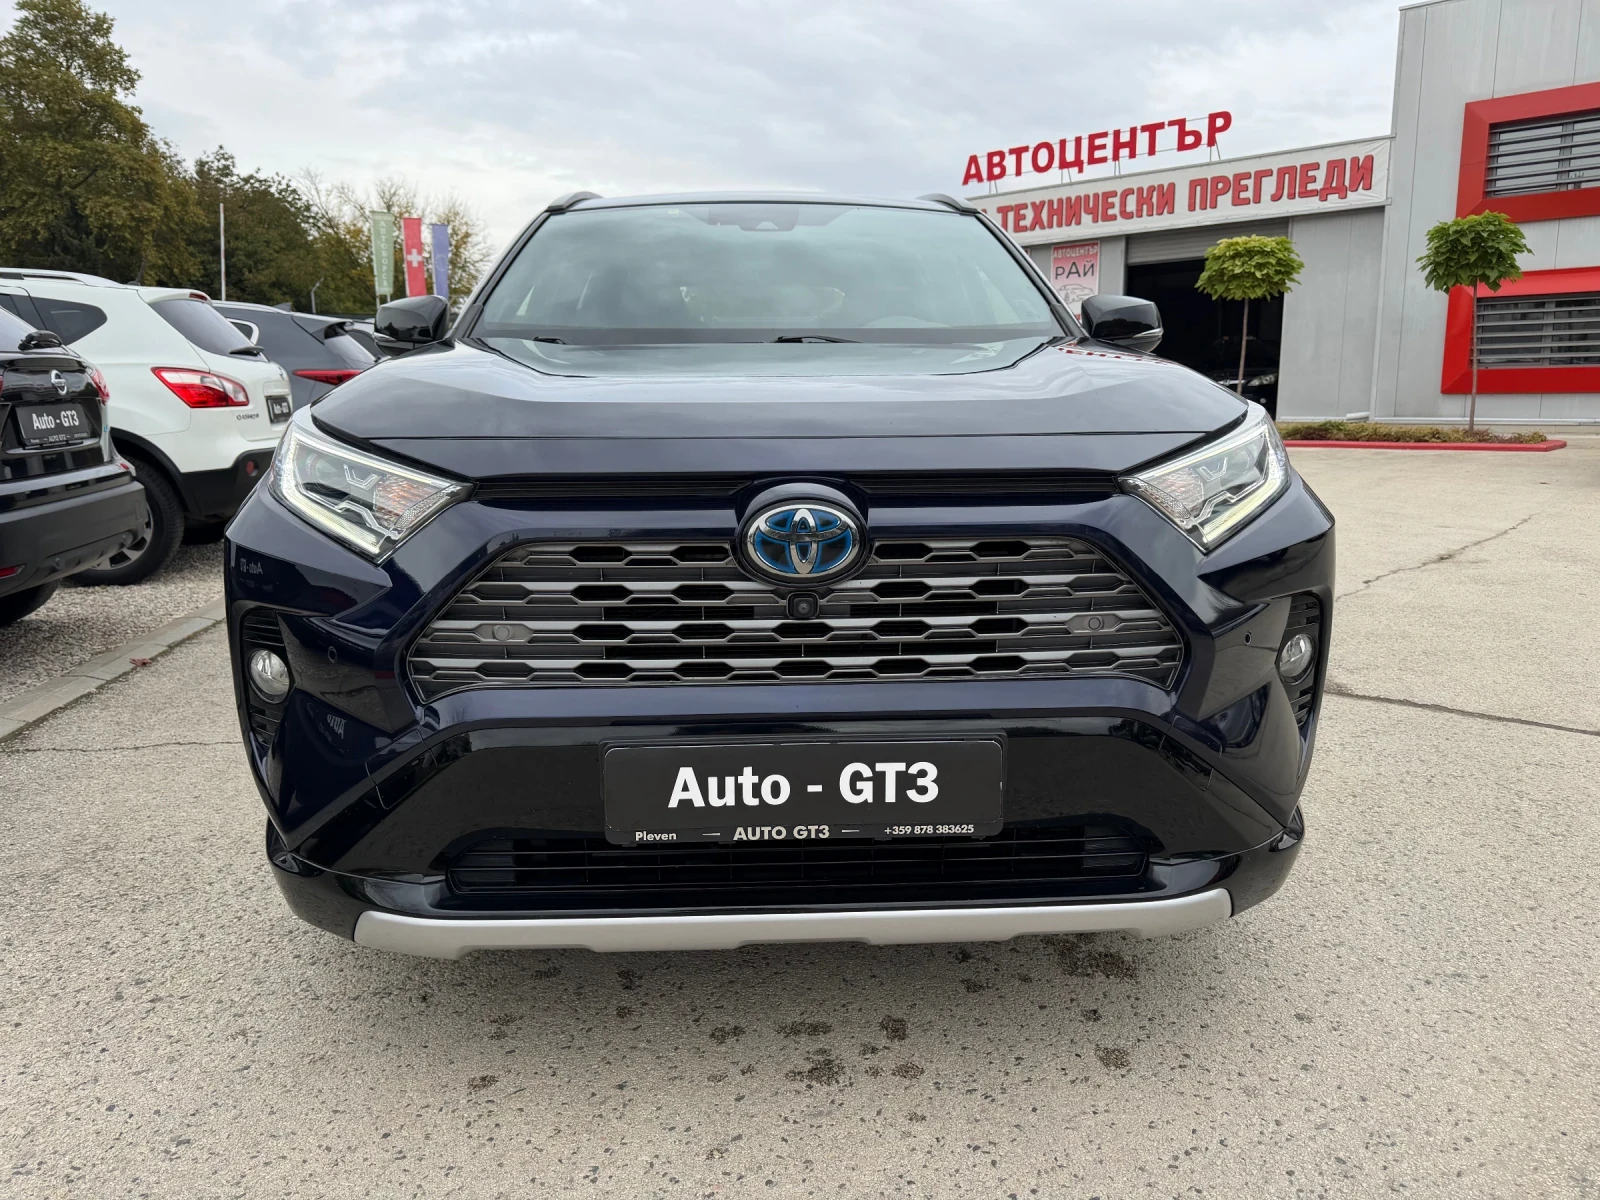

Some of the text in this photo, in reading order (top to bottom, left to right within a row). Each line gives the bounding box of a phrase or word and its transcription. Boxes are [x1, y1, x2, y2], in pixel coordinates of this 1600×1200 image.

[962, 111, 1232, 186] АВТОЦЕНТЪР
[996, 154, 1374, 233] ТЕХНИЧЕСКИ ПРЕГЛЕДИ
[1053, 245, 1098, 258] АВТОЦЕНТЪР
[32, 412, 55, 430] Auto
[60, 410, 79, 427] GT3
[668, 766, 790, 808] Auto
[839, 761, 939, 804] GT3
[635, 830, 677, 842] Pleven
[733, 825, 830, 841] AUTO GT3
[884, 824, 974, 836] +359 878 383625
